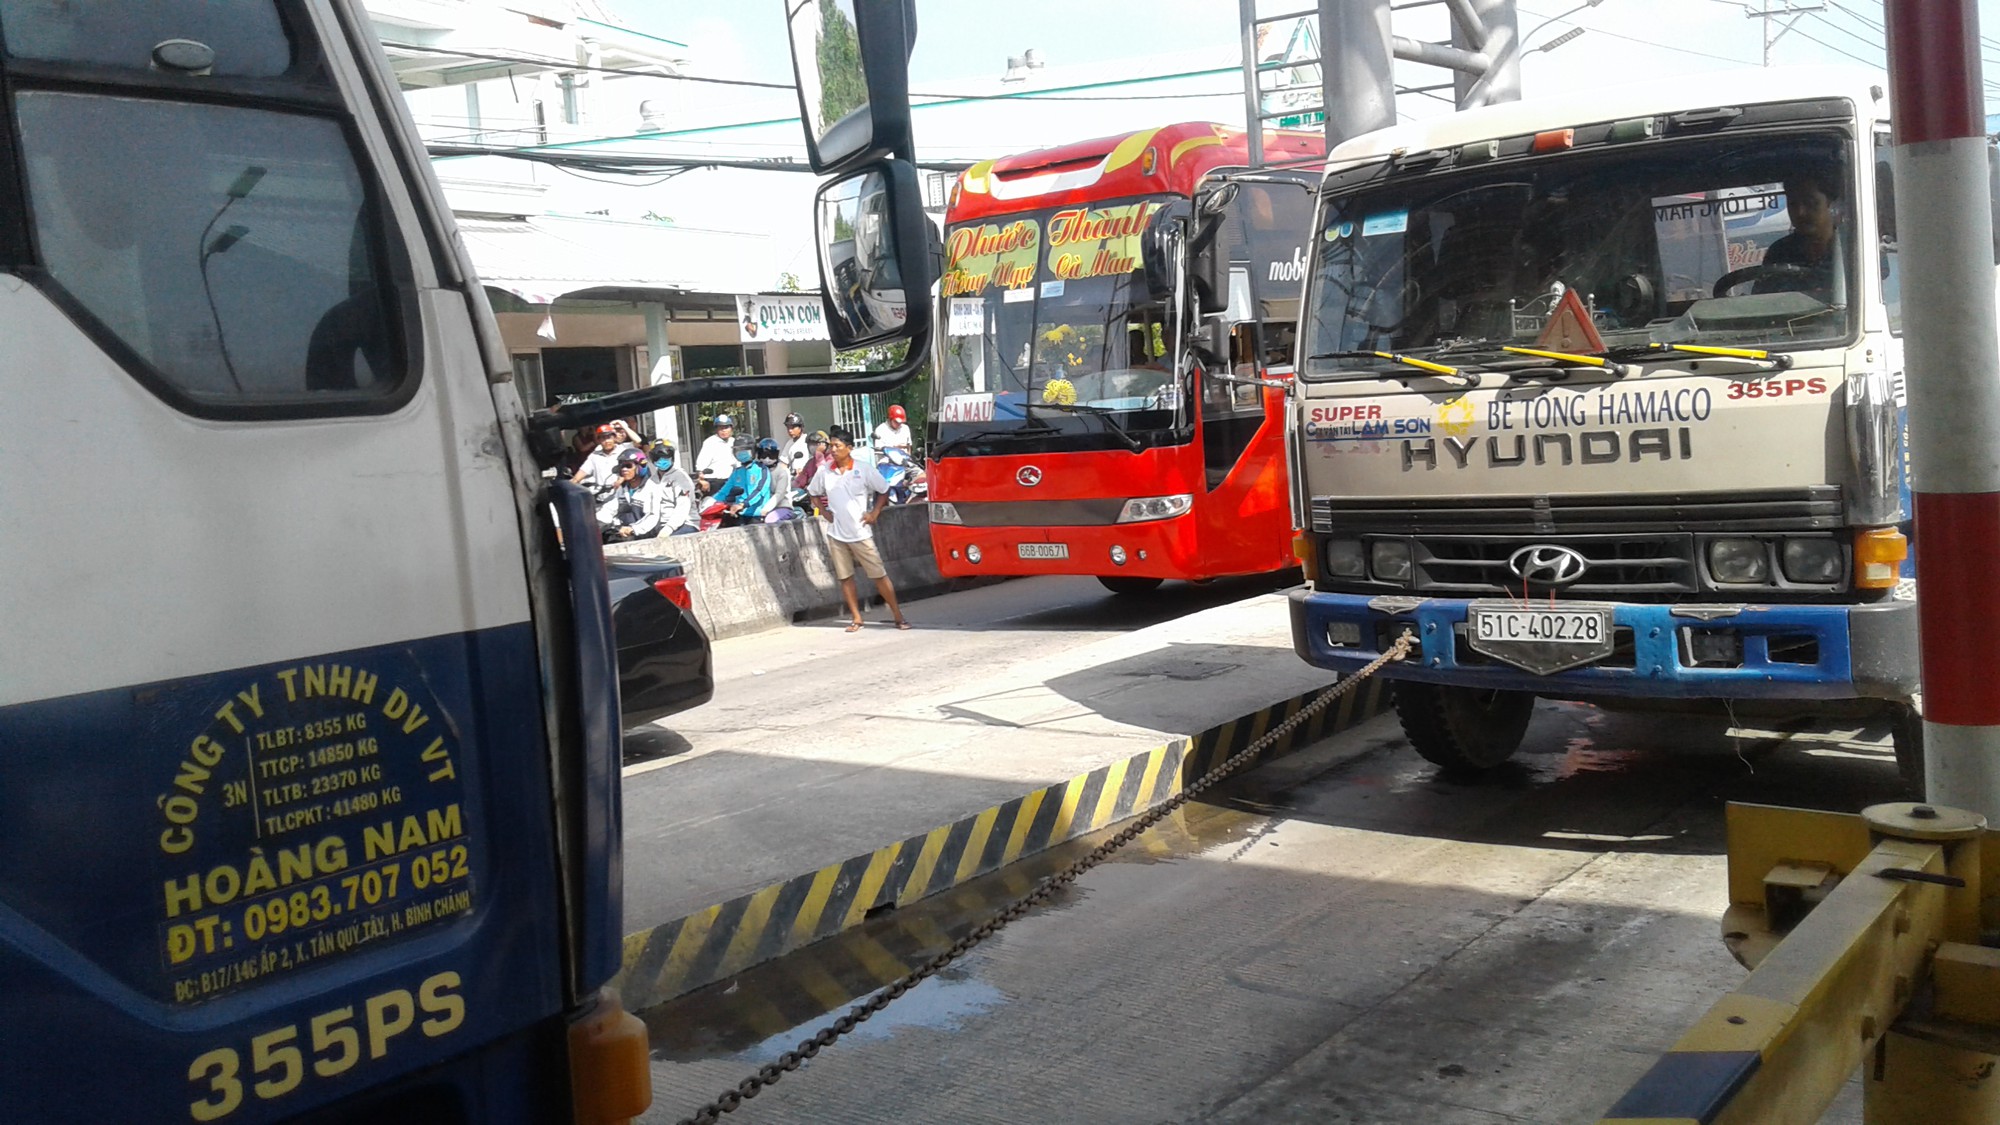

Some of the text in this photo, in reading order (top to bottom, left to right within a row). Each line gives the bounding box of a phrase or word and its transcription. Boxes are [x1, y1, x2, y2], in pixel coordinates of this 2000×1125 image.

[1048, 200, 1153, 247] Thành
[1084, 249, 1135, 277] Mau
[760, 299, 821, 329] QUÁN CƠM
[1727, 377, 1828, 401] 355PS
[944, 397, 992, 422] CÀ MAU
[1311, 405, 1382, 422] SUPER
[1394, 417, 1431, 434] SƠN
[1487, 387, 1711, 431] BÊ TÔNG HAMACO
[1401, 427, 1693, 472] HYUNDAI
[1481, 614, 1599, 640] 51C-402.28
[304, 717, 342, 741] 8355
[346, 712, 366, 732] KG
[157, 664, 456, 854] CÔNG TY TNHH DV VT
[260, 737, 378, 778] TTCP: 14850 KG
[223, 780, 248, 807] 3N
[263, 764, 381, 806] TLTB: 23370 KG
[333, 792, 378, 818] 41480
[382, 786, 401, 805] KG
[164, 803, 463, 918] HOÀNG NAM
[245, 864, 400, 940] 0983.707
[411, 845, 469, 890] 052
[296, 942, 309, 963] X.
[310, 931, 335, 957] TÂN
[391, 911, 404, 932] H.
[405, 902, 432, 926] BÌNH
[434, 889, 470, 918] CHÁNH
[188, 971, 465, 1122] 355PS
